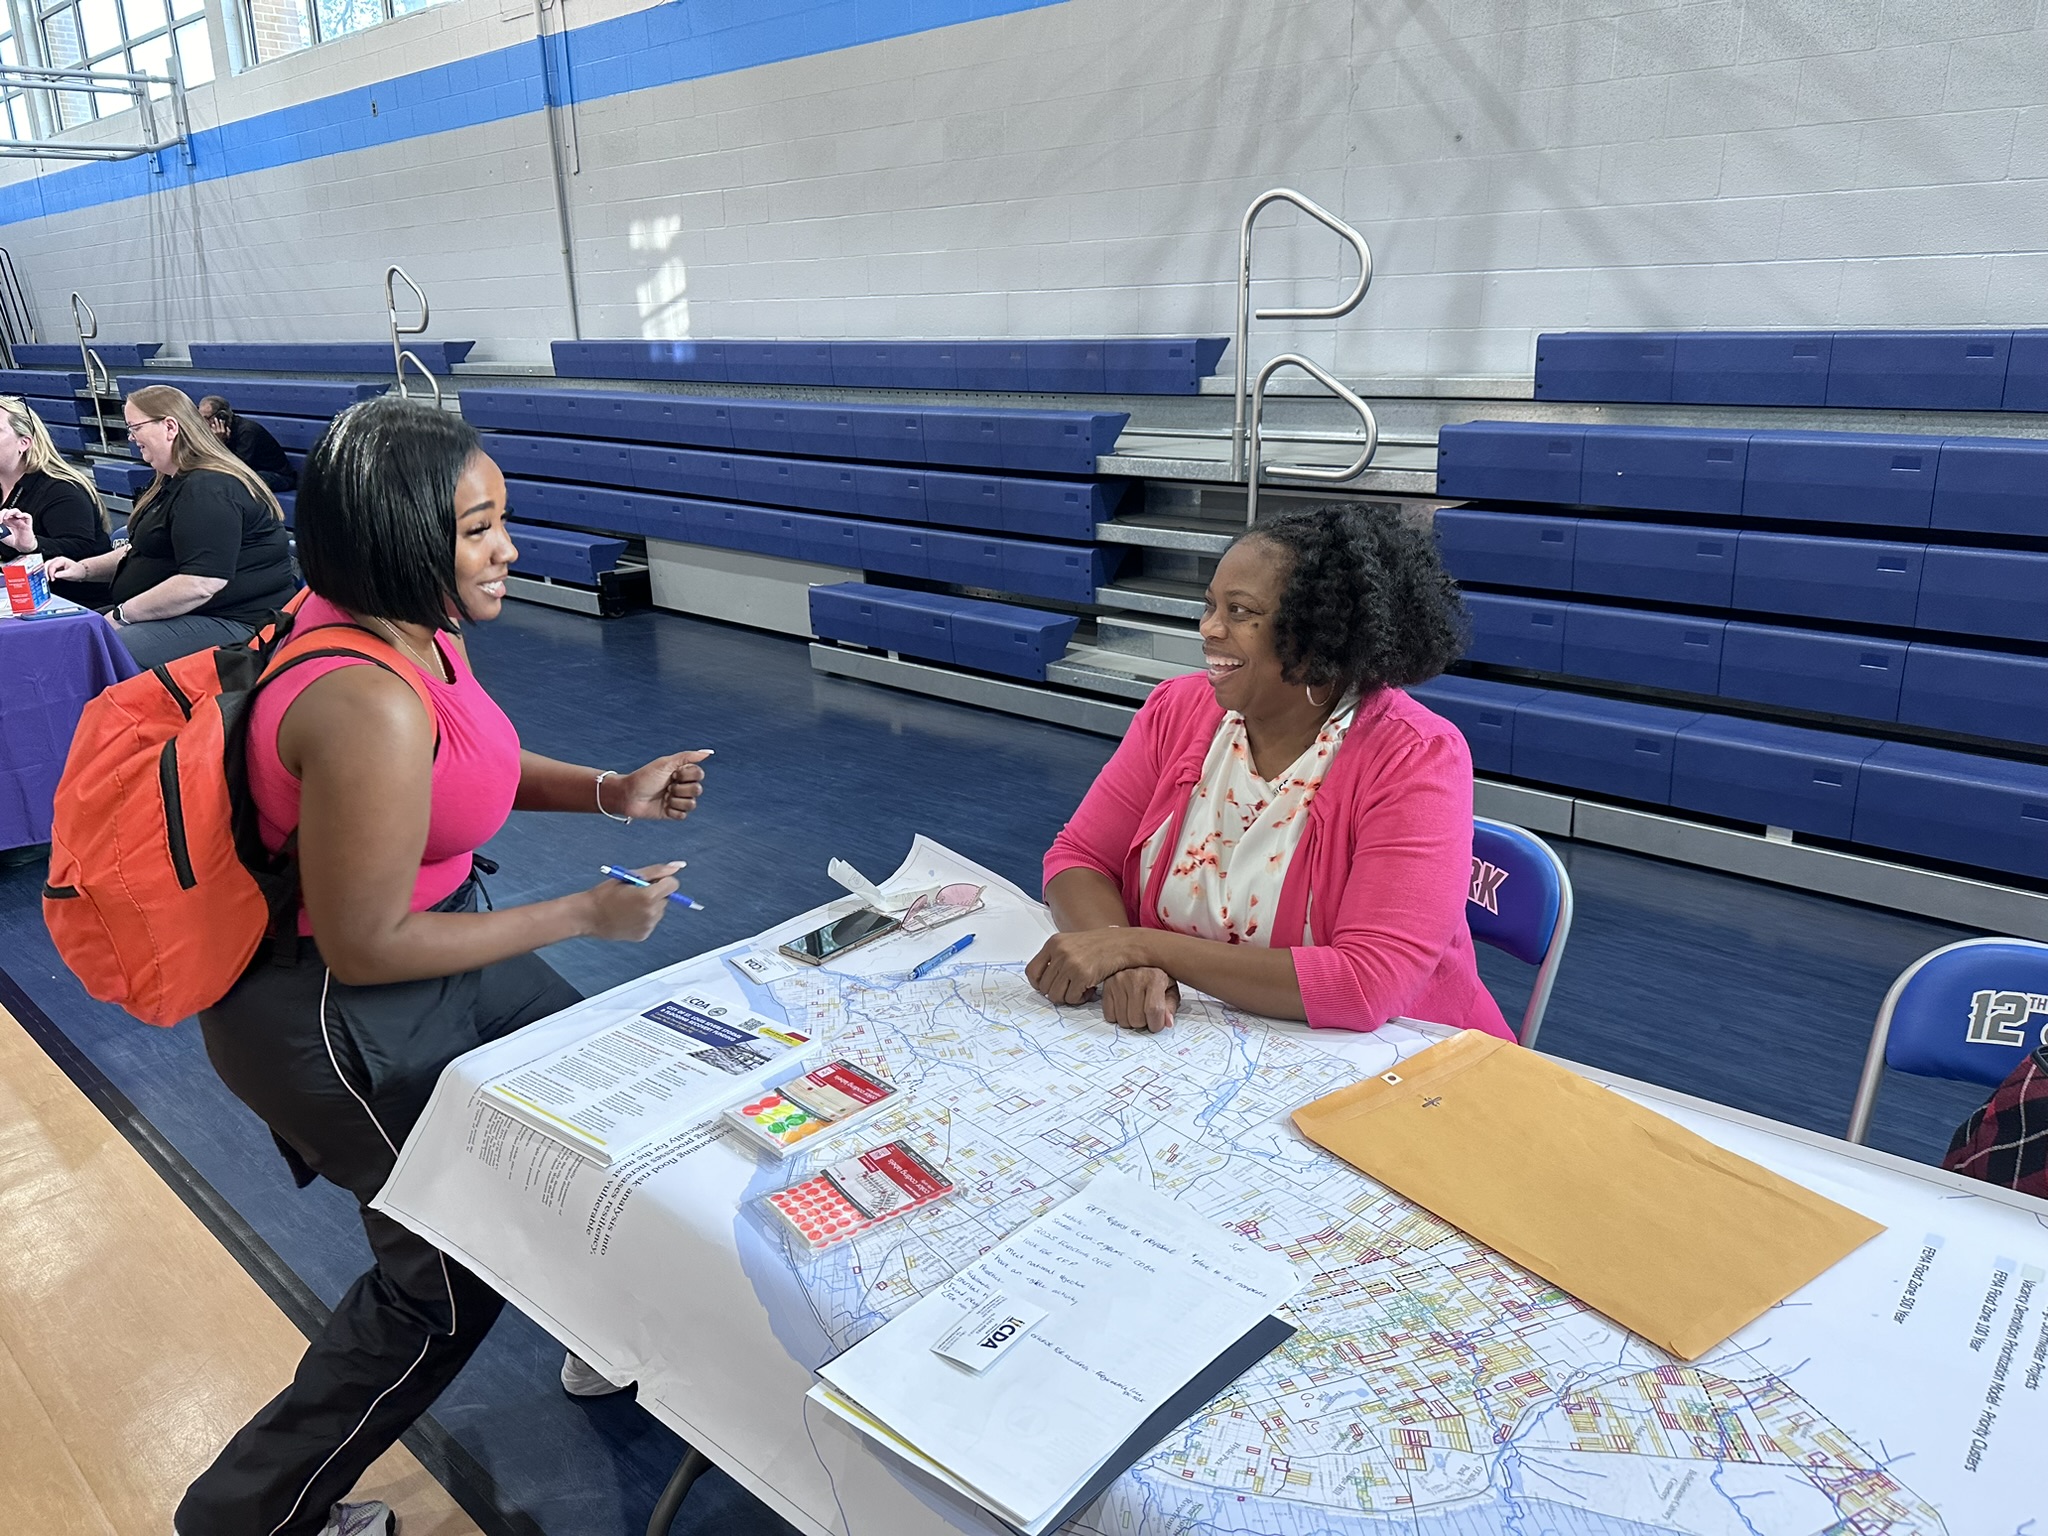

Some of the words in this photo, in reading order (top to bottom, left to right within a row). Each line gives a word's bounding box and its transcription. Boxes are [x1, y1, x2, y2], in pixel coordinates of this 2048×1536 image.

[1468, 856, 1509, 916] RK
[689, 998, 710, 1009] CDA
[846, 1078, 864, 1093] coding
[669, 1120, 713, 1144] especially
[650, 1138, 694, 1162] processes
[654, 1142, 669, 1152] for
[676, 1128, 734, 1158] ncorporating
[636, 1150, 653, 1160] the
[612, 1159, 636, 1178] most
[652, 1158, 678, 1174] flood
[887, 1158, 903, 1172] labels
[611, 1162, 650, 1199] increases
[632, 1172, 652, 1187] risk
[899, 1167, 918, 1185] coding
[915, 1181, 930, 1194] color
[586, 1180, 614, 1236] vulnerable
[608, 1188, 632, 1232] analysis
[590, 1200, 612, 1254] resiliency,
[600, 1234, 612, 1256] into
[1919, 1246, 1936, 1264] FEMA
[1912, 1262, 1930, 1282] Flood
[1990, 1270, 2008, 1288] FEMA
[1904, 1279, 1922, 1296] Zone
[1984, 1286, 2002, 1307] Flood
[2015, 1280, 2037, 1304] Vacancy
[1900, 1295, 1916, 1310] 500
[1893, 1308, 1910, 1324] Year
[1978, 1304, 1996, 1322] Zone
[2005, 1303, 2030, 1340] Demolition
[979, 1322, 1016, 1350] CDA
[1974, 1322, 1990, 1337] 100
[1969, 1336, 1986, 1352] Year
[1992, 1338, 2018, 1382] Prioritization
[2025, 1360, 2046, 1390] Projects
[1986, 1380, 2006, 1407] Model
[1972, 1409, 1996, 1440] Priority
[1964, 1438, 1988, 1472] Clusters
[1456, 1463, 1470, 1476] Park
[1332, 1483, 1345, 1496] Hill
